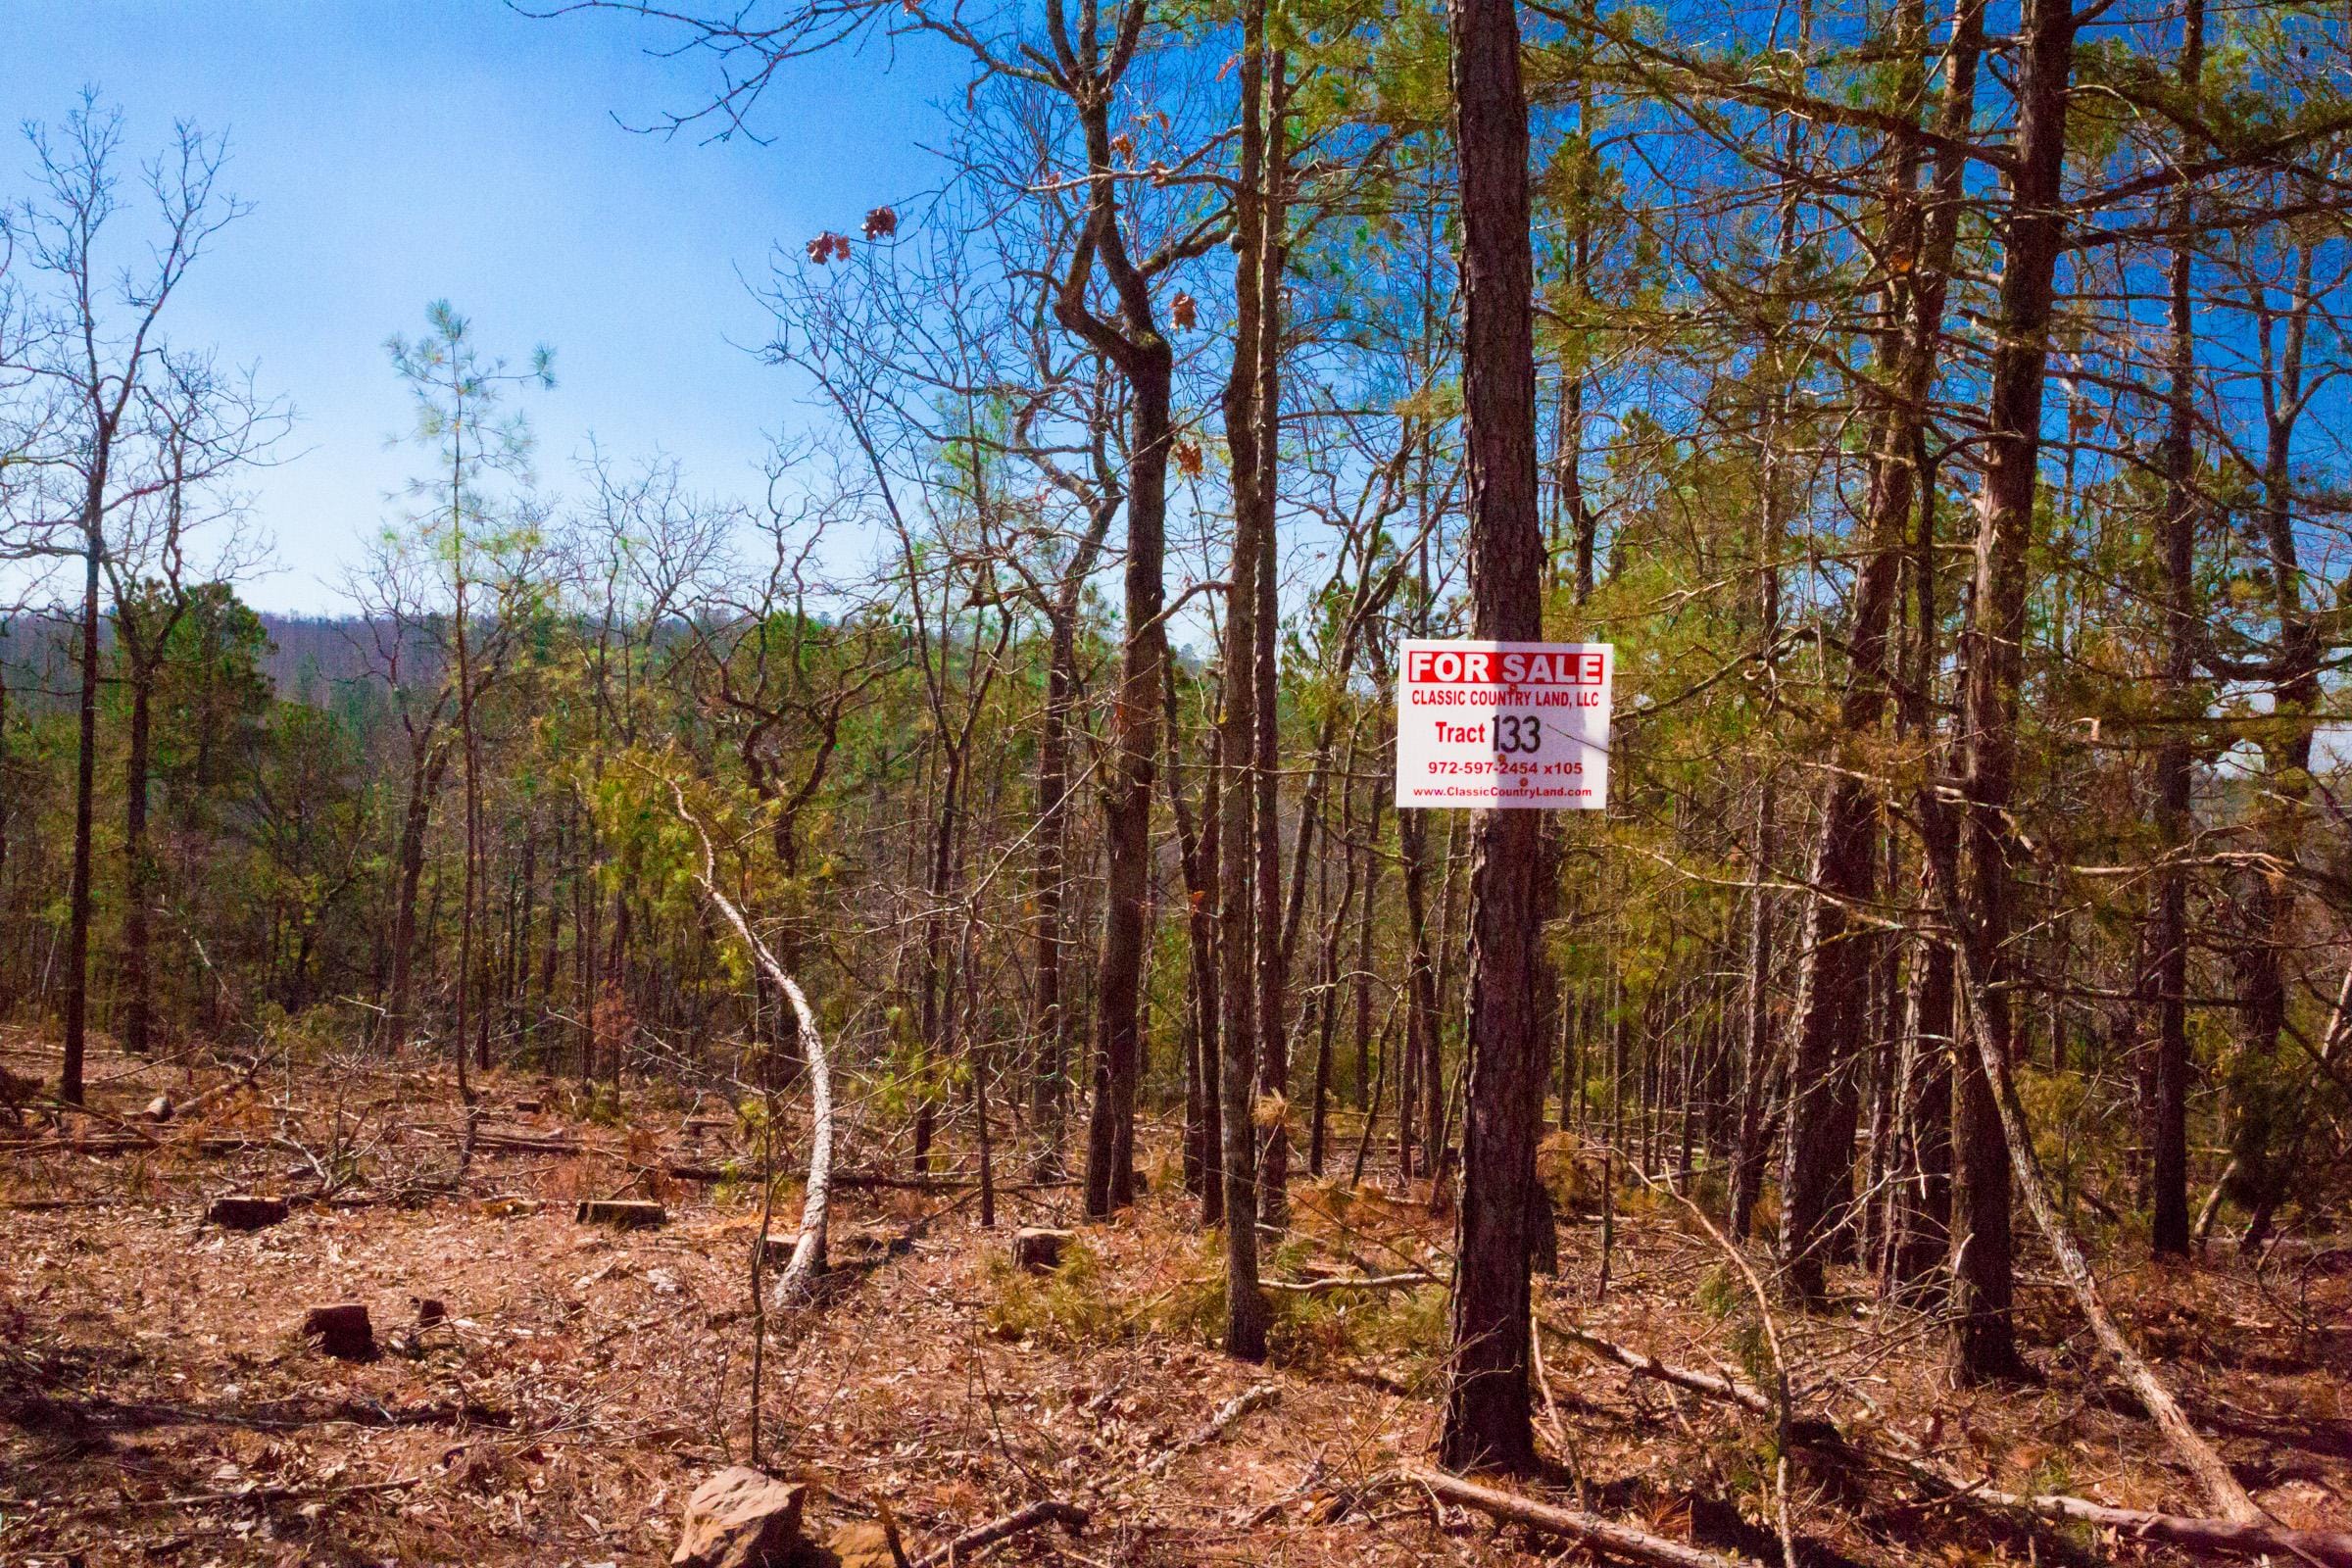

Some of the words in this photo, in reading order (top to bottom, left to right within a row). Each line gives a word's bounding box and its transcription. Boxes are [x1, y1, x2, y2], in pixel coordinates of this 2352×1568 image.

[1411, 653, 1490, 682] FOR
[1502, 654, 1600, 683] SALE
[1412, 690, 1466, 705] CLASSIC
[1470, 690, 1531, 706] COUNTRY
[1536, 691, 1572, 710] LAND,
[1577, 692, 1598, 706] LLC
[1435, 721, 1485, 743] Tract
[1492, 714, 1541, 754] 133
[1428, 761, 1538, 774] 972-597-2454
[1544, 761, 1583, 774] x105
[1413, 786, 1592, 799] www.ClassicCountryLand.com
